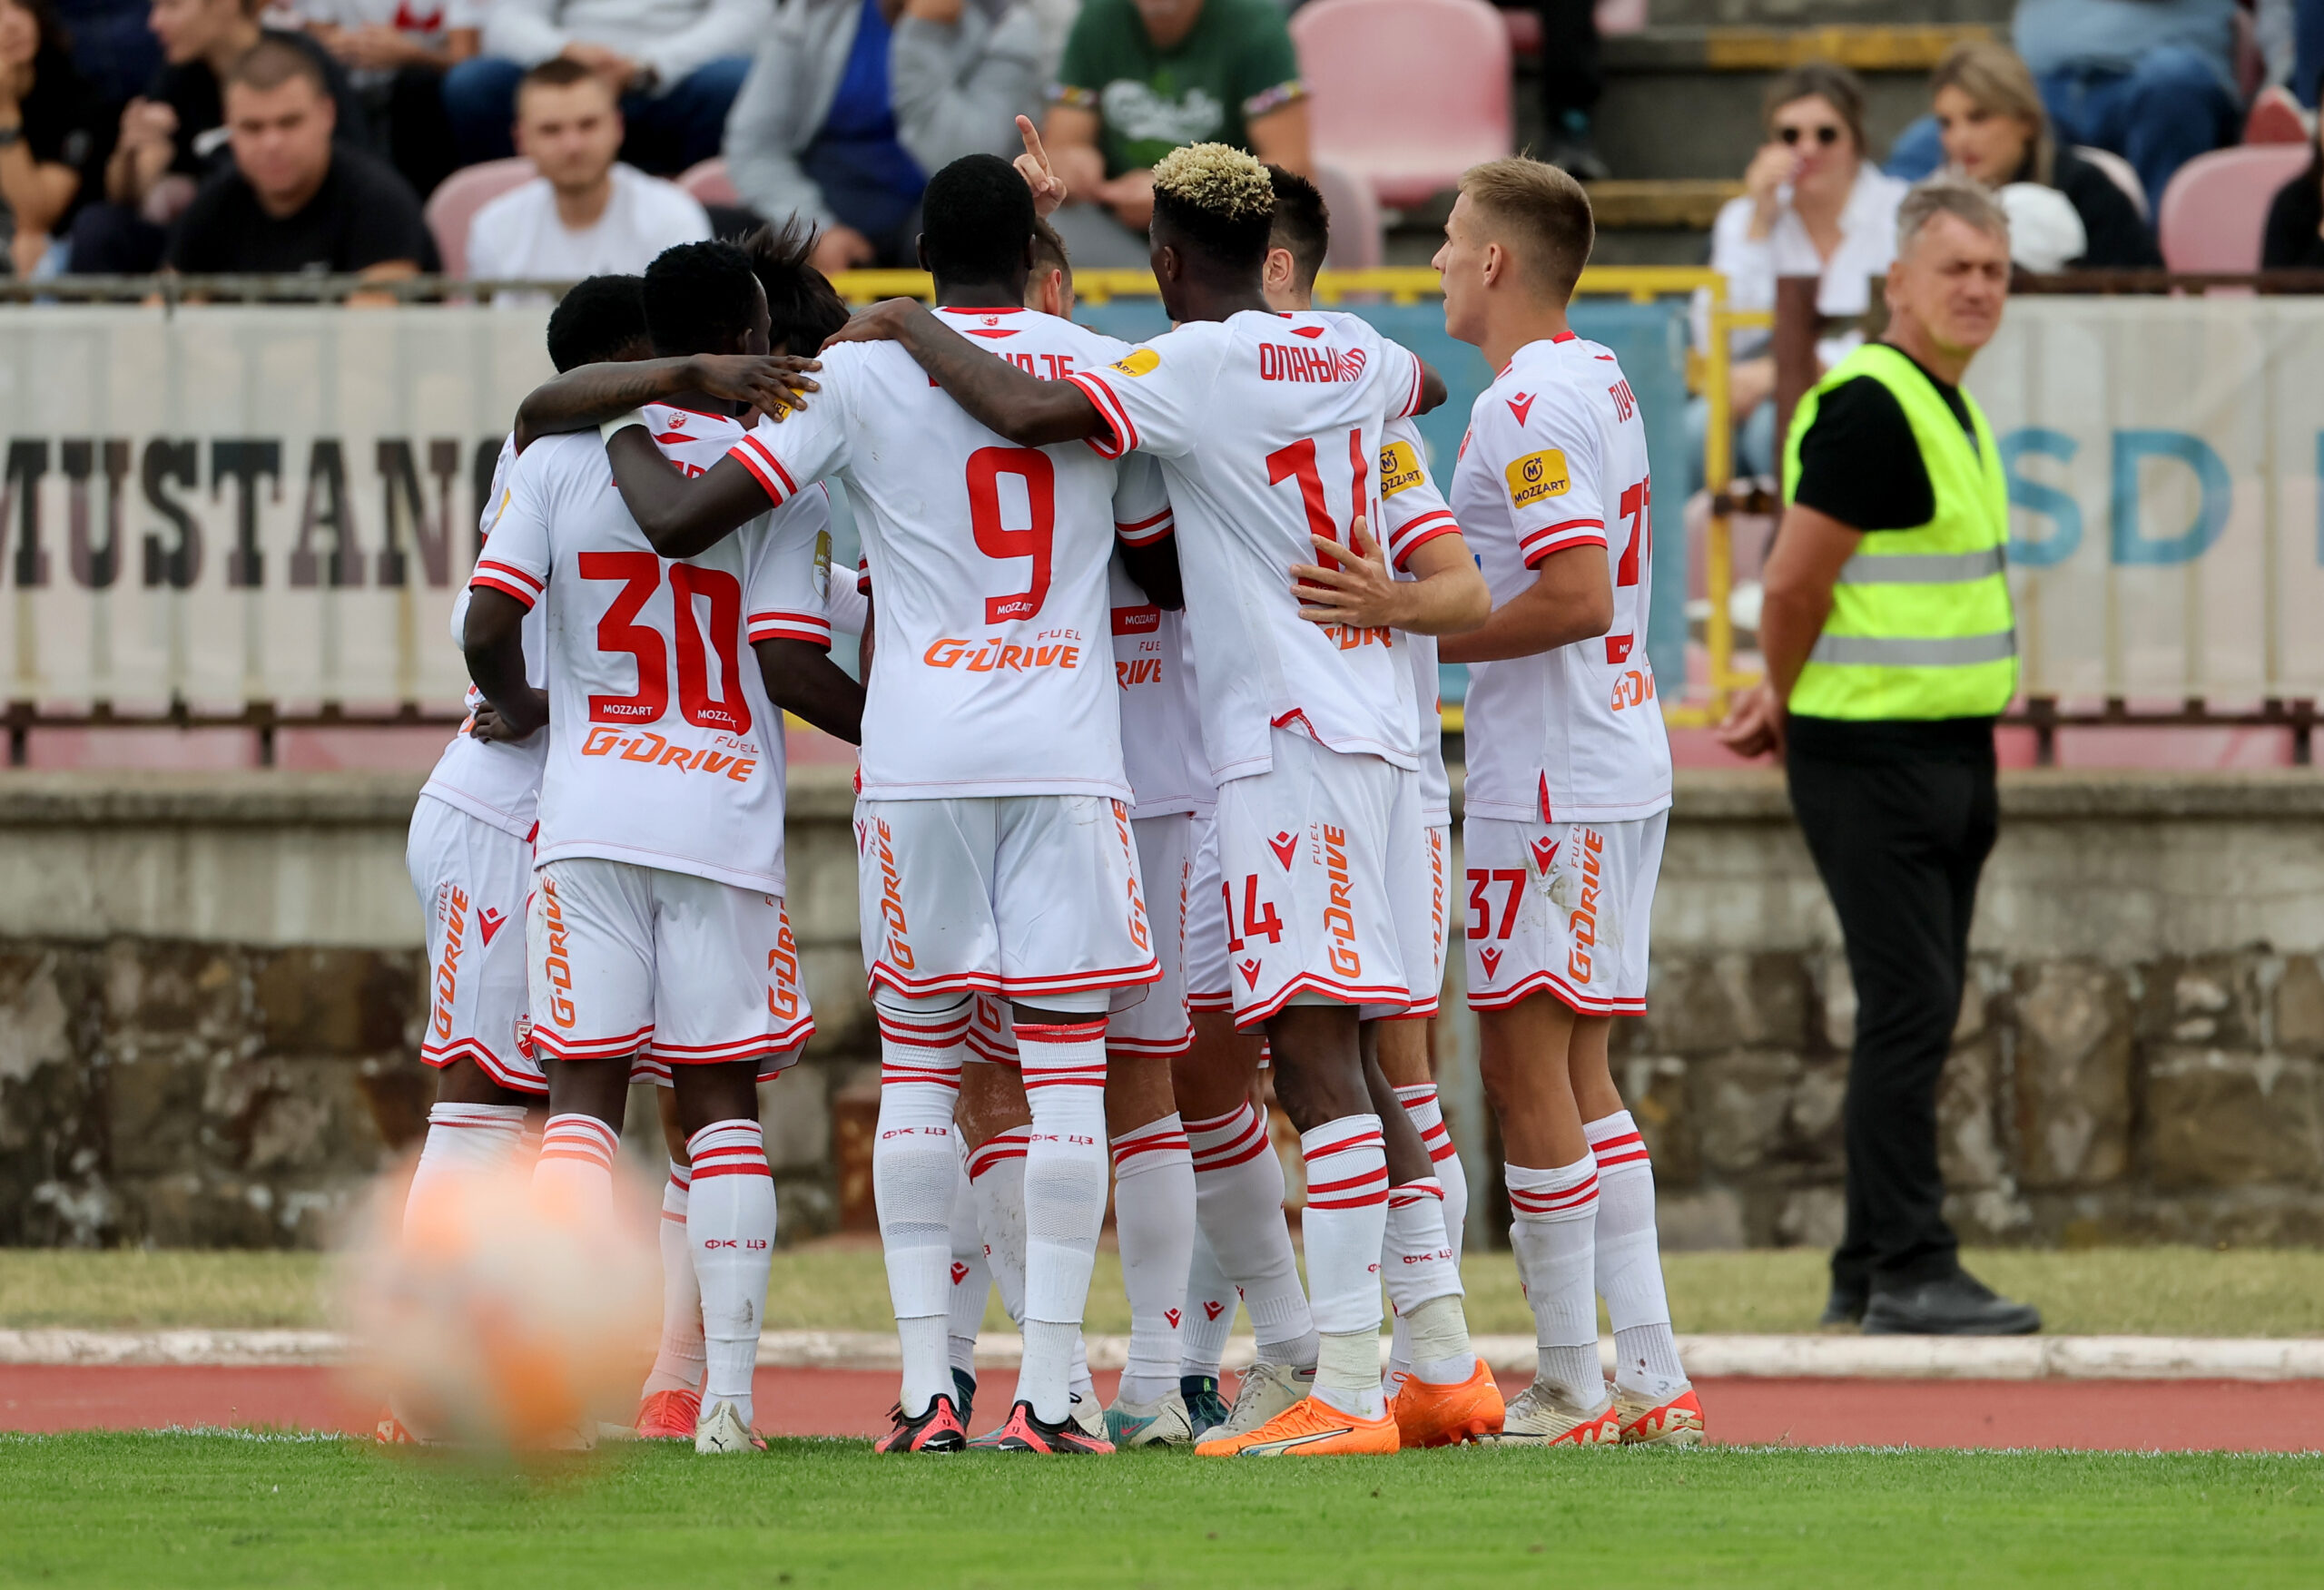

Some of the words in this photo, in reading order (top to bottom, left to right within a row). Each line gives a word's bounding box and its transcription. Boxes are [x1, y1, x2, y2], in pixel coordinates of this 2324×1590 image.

[1380, 469, 1420, 496] OZZART
[1514, 478, 1566, 505] MOZZART
[966, 447, 1055, 624] 9
[578, 551, 753, 737] 30
[1037, 629, 1082, 642] FUEL
[1138, 641, 1163, 653] FUE
[603, 704, 654, 717] MOZZART
[714, 735, 759, 754] FUEL
[1310, 821, 1322, 866] FUEL
[1571, 824, 1581, 869] FUEL
[438, 880, 449, 923] FUEL
[1221, 873, 1284, 955] 14
[1466, 869, 1527, 940] 37
[704, 1239, 737, 1250] ФК
